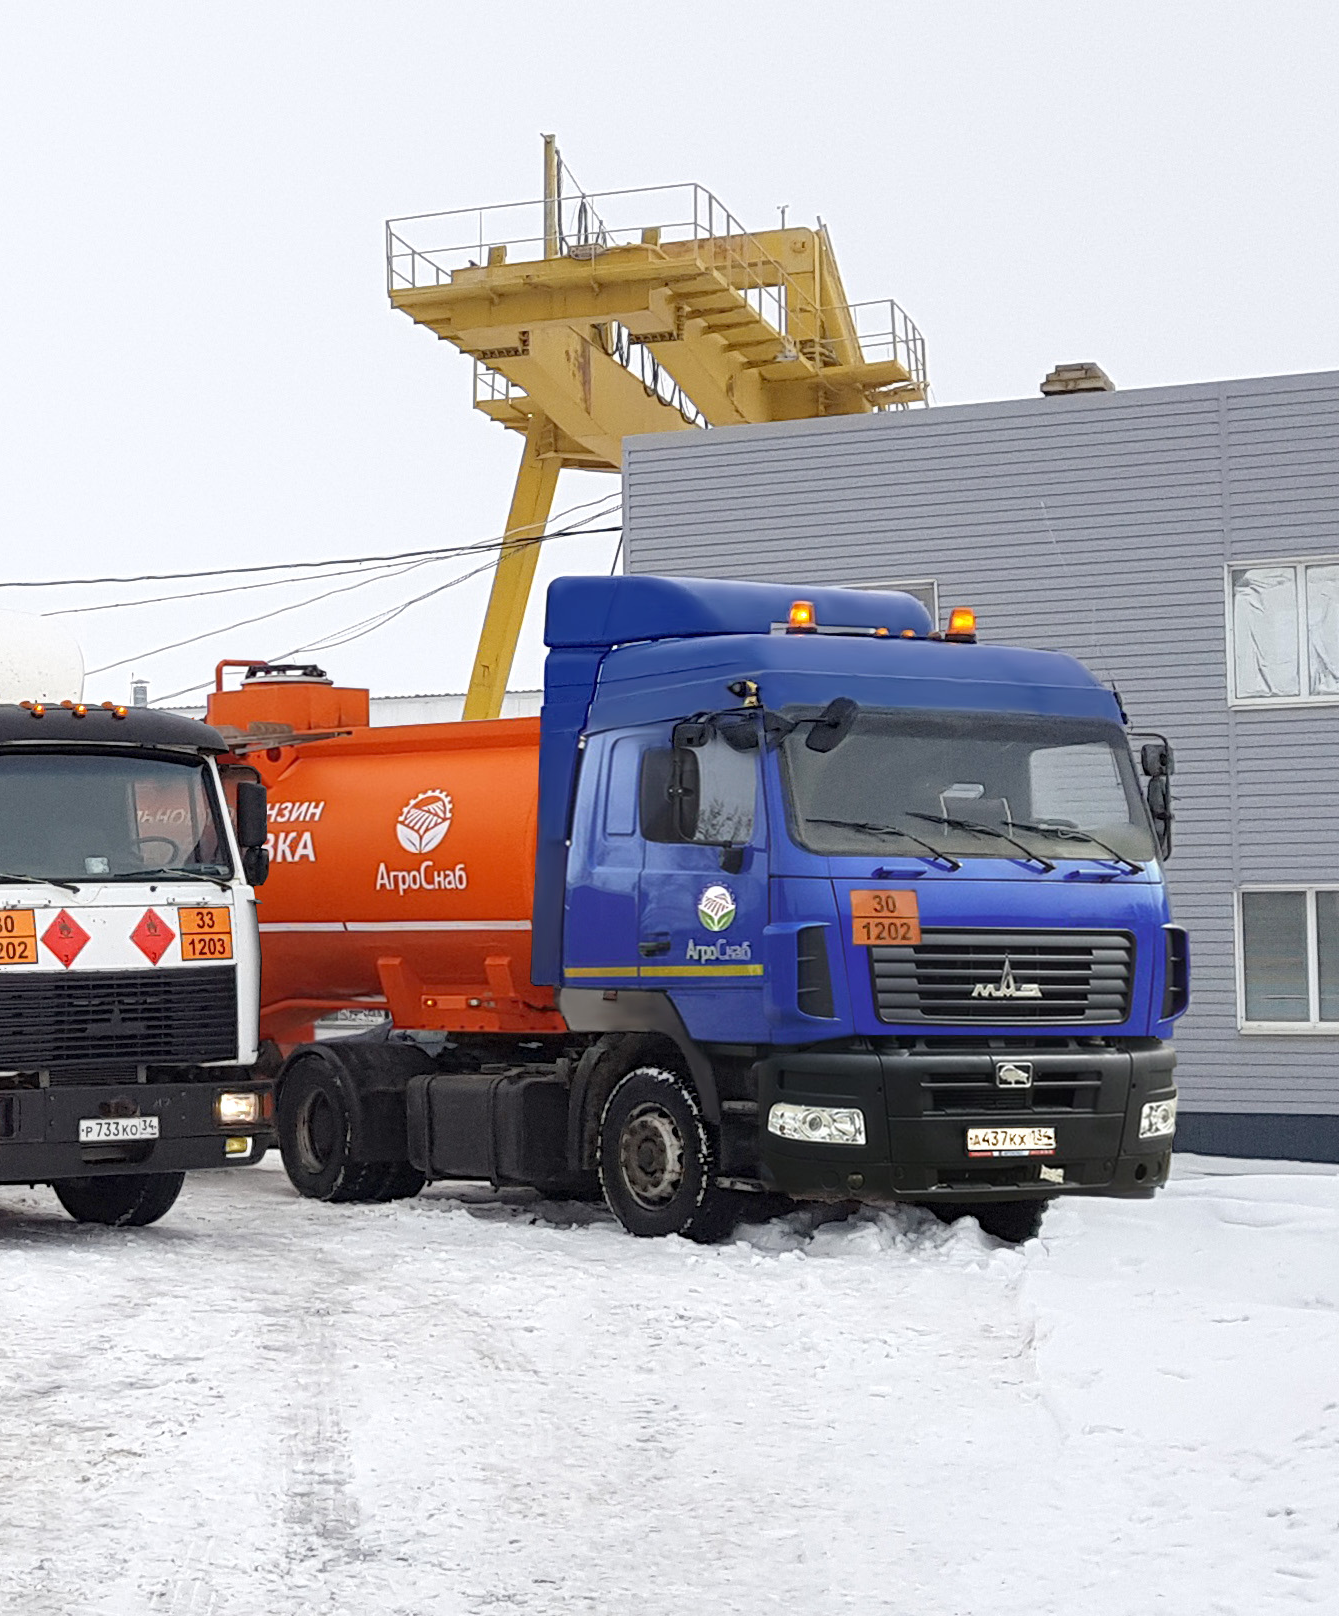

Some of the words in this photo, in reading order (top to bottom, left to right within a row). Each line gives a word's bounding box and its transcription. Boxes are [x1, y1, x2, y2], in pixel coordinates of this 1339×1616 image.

[266, 801, 325, 822] НЗИН
[376, 861, 467, 896] АгроСнаб
[873, 895, 897, 913] 30
[196, 911, 215, 929] 33
[862, 921, 913, 941] 1202
[188, 938, 226, 956] 1203
[686, 939, 751, 964] АгроСнаб
